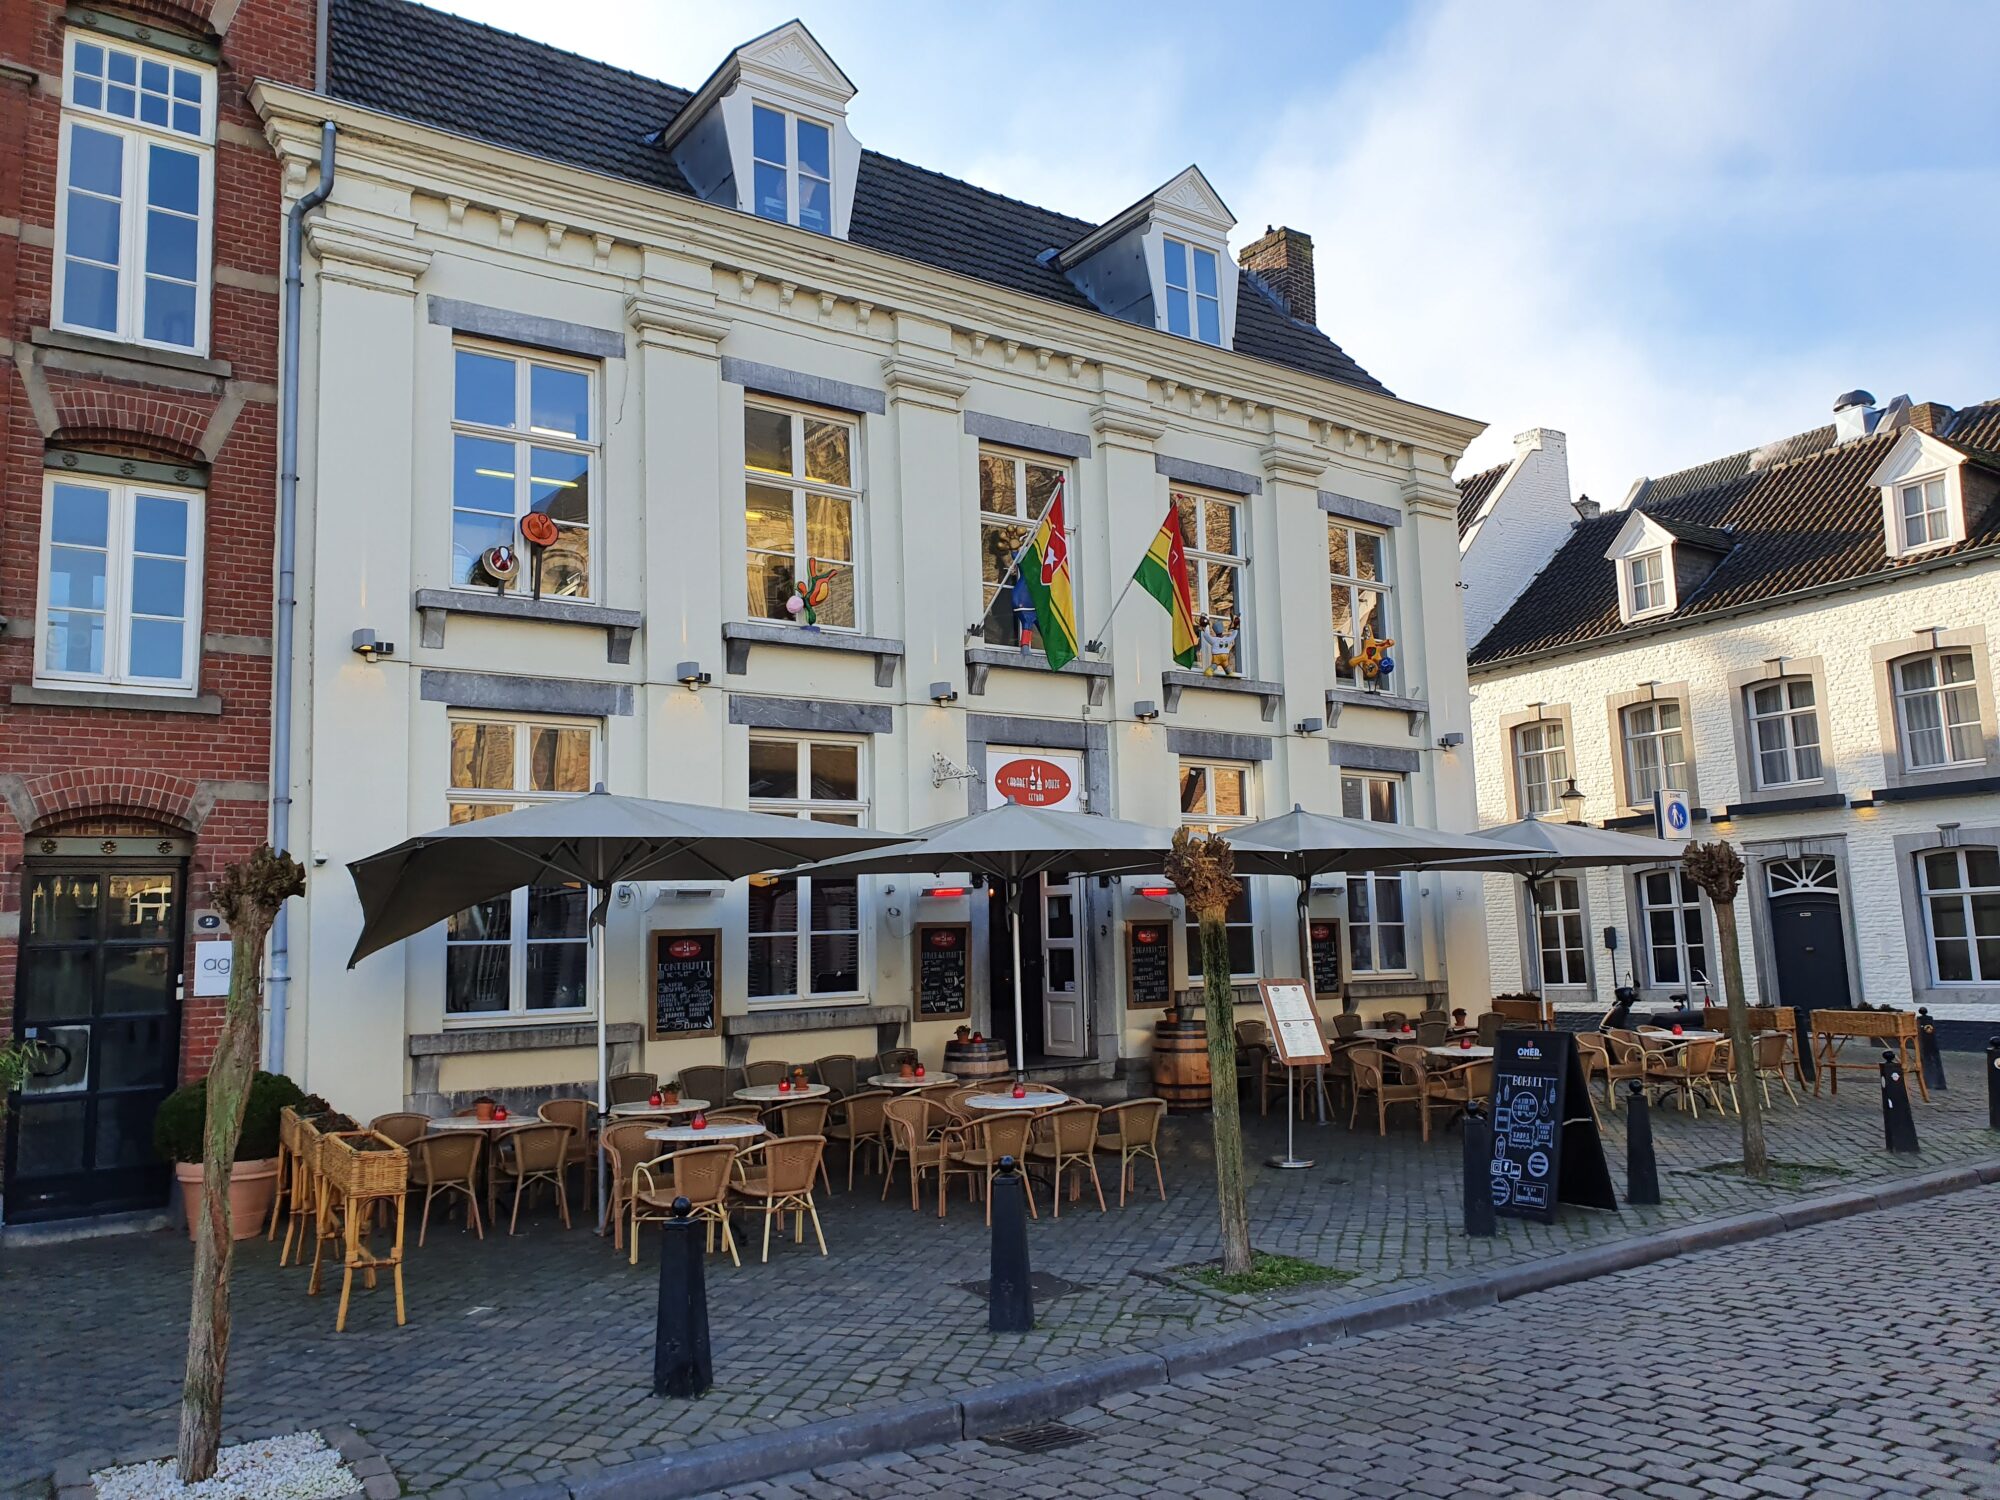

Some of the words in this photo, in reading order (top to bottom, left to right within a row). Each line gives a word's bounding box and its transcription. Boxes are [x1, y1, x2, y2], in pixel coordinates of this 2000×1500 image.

[205, 917, 213, 926] 2
[1100, 924, 1107, 937] 3
[1517, 1047, 1543, 1057] OMER.
